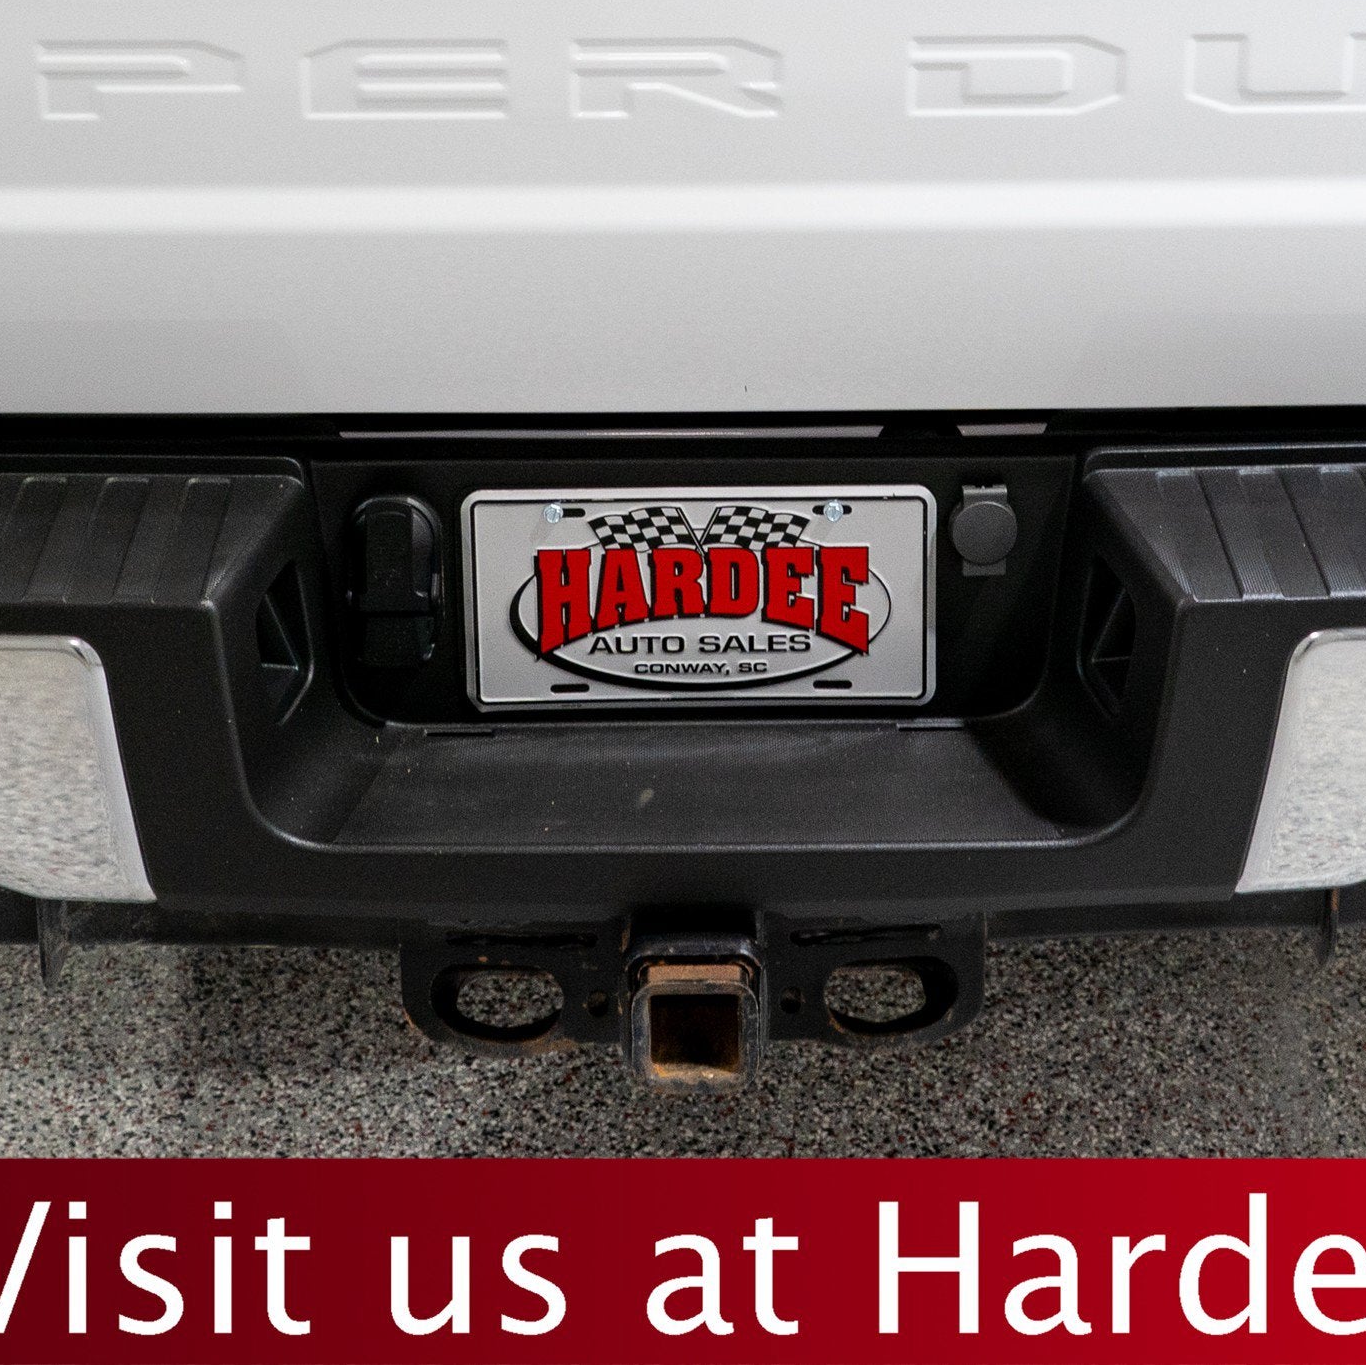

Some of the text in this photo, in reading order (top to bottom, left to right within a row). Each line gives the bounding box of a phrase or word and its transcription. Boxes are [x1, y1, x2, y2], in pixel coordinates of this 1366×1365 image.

[535, 546, 870, 657] HARDEE
[589, 634, 812, 655] AUTO SALES
[634, 662, 768, 675] CONWAY, SC
